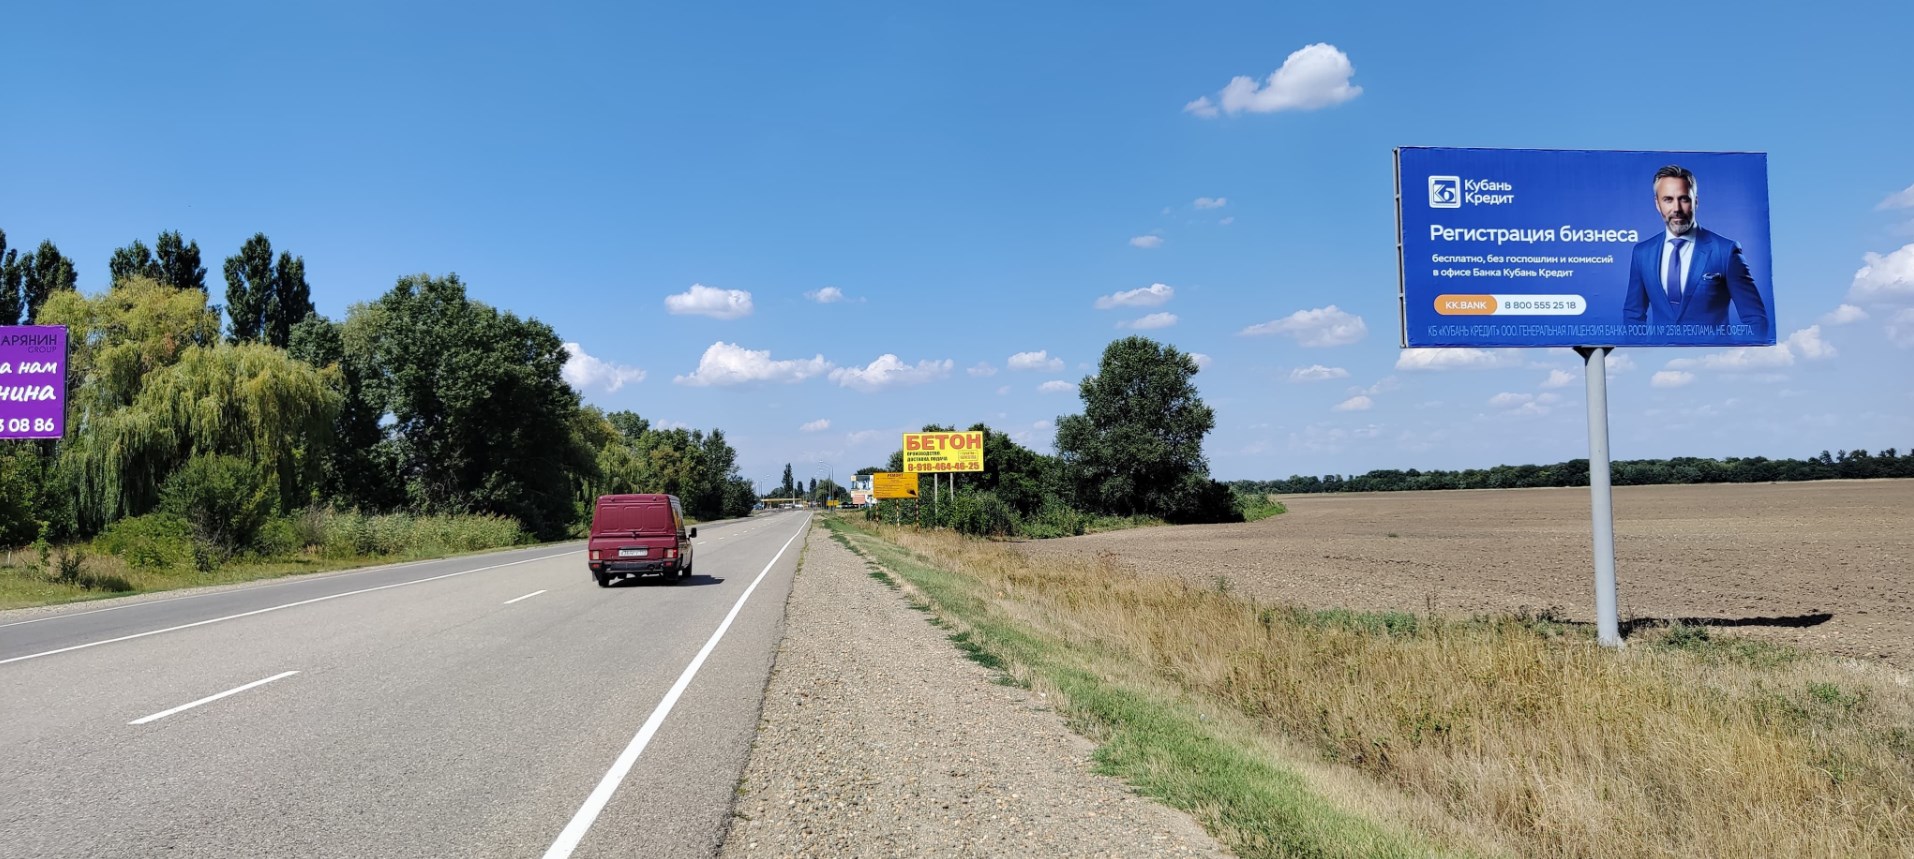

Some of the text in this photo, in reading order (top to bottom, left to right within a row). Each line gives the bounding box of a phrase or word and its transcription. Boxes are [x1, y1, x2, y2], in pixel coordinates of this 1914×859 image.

[1464, 179, 1512, 193] Кубань
[1465, 192, 1514, 206] Кредит
[1430, 224, 1638, 246] Регистрация бизнеса
[1432, 254, 1485, 264] бесплатно,
[1487, 254, 1504, 263] без
[1568, 255, 1613, 264] комиссий
[1441, 268, 1471, 278] офисе
[1473, 268, 1501, 277] Банка
[1503, 268, 1537, 278] Кубань
[1539, 269, 1574, 278] Кредит
[1445, 301, 1487, 310] KK.BANK
[1504, 301, 1576, 309] 8 800 555 25 18
[18, 362, 57, 374] нам
[8, 418, 30, 432] 08
[34, 418, 55, 432] 86
[906, 434, 981, 450] БЕТОН
